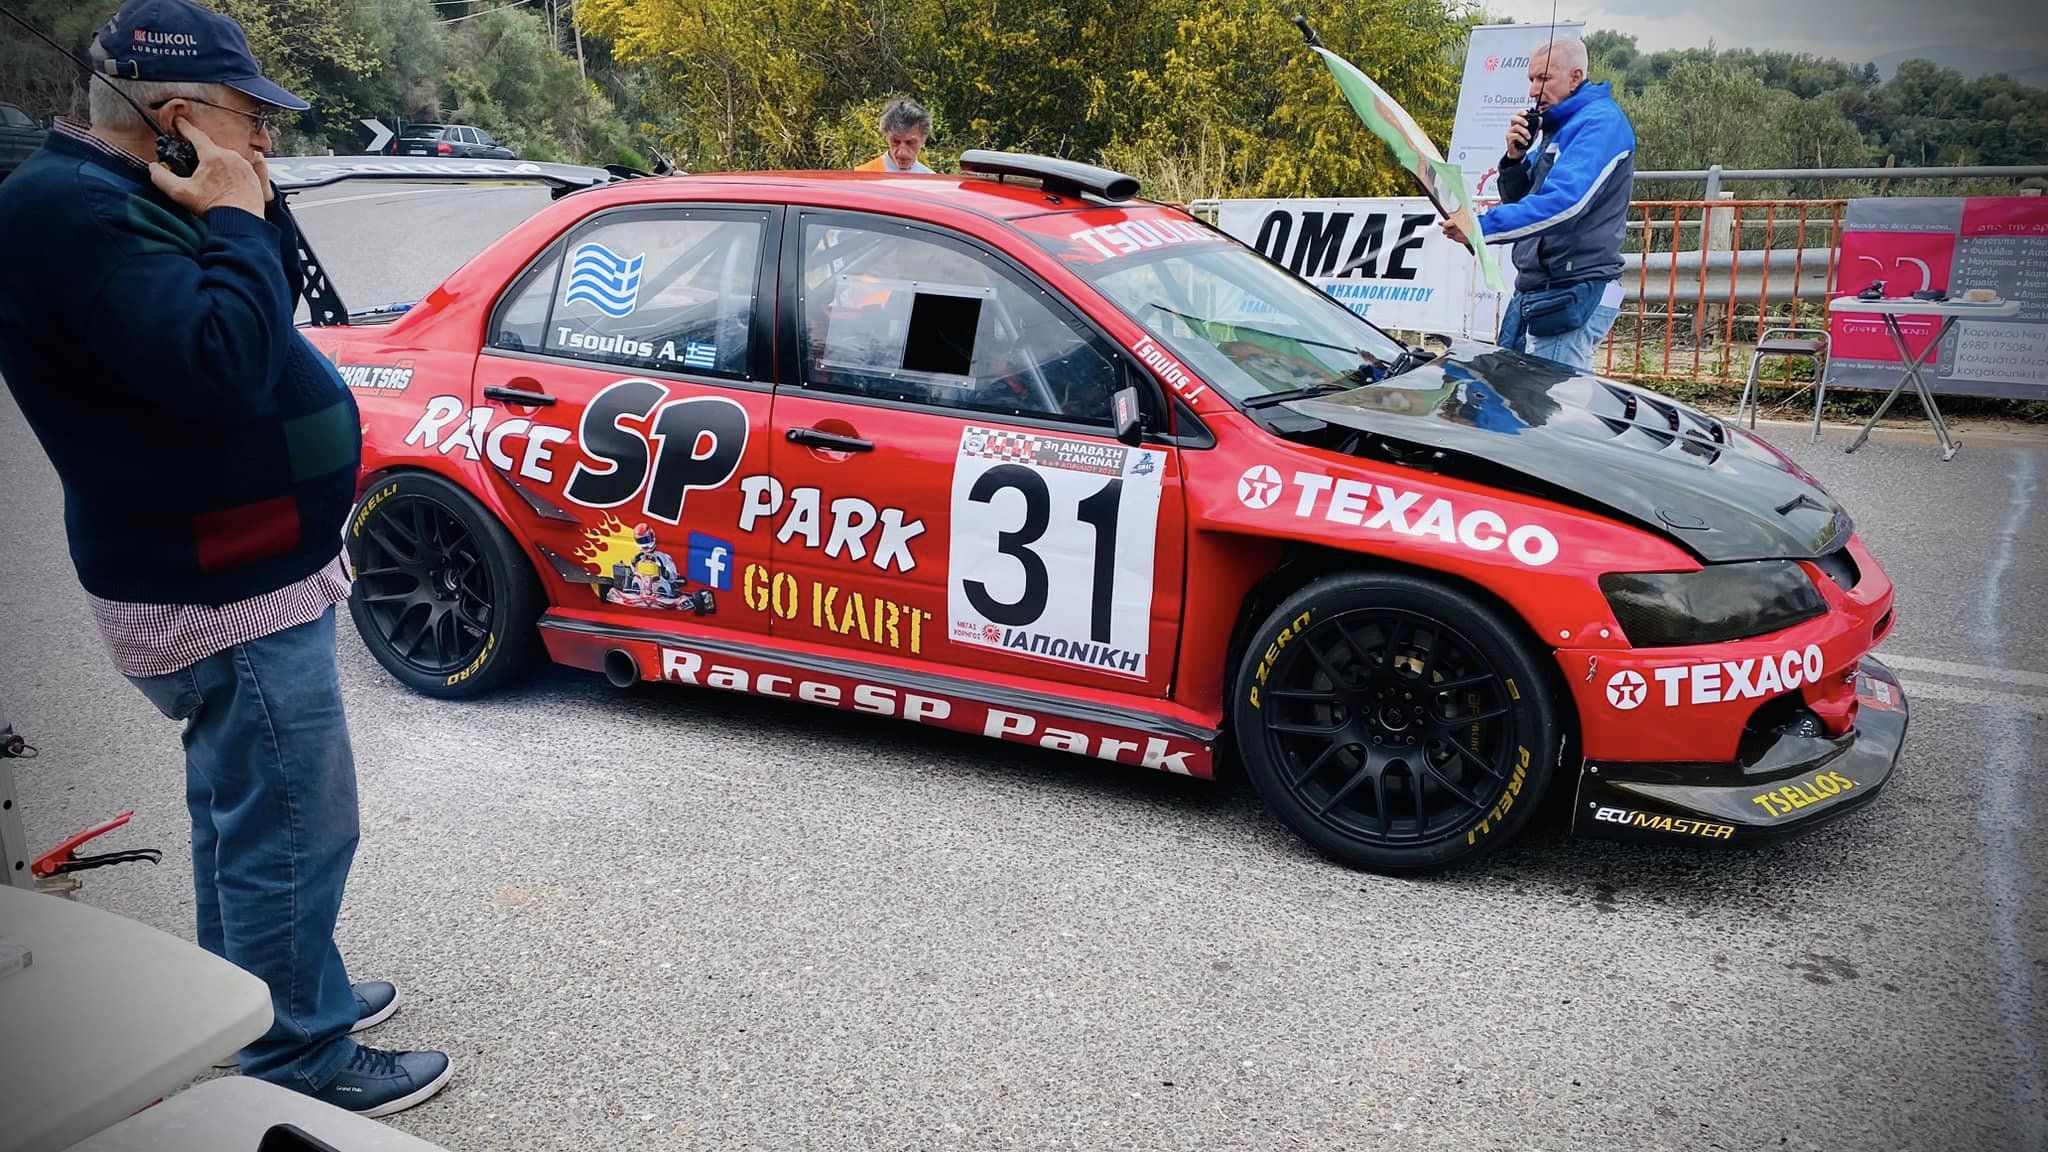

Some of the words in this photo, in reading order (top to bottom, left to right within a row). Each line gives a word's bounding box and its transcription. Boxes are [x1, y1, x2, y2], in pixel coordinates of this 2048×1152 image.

[132, 44, 198, 56] LUBRICANTS
[147, 32, 198, 47] LUKOIL
[1326, 284, 1434, 302] ΜΗΧΑΝΟΚΙΝΗΤΟΥ
[558, 326, 653, 357] Tsoulos
[658, 340, 684, 362] A.
[1132, 334, 1190, 390] Tsoulos
[1184, 385, 1206, 404] J.
[403, 395, 573, 483] RACE
[563, 378, 750, 525] SP
[738, 475, 926, 573] PARK
[1057, 452, 1121, 469] ΤΣΑΚΩΝΑΣ
[1060, 442, 1123, 459] ΑΝΑΒΑΣΗ
[353, 483, 398, 537] PIRELLI
[1293, 471, 1559, 566] TEXACO
[962, 463, 1124, 645] 31
[743, 563, 799, 620] GO
[812, 581, 932, 654] KART
[1002, 628, 1141, 672] ΙΑΠΩΝΙΚΗ
[1654, 643, 1824, 707] TEXACO
[662, 648, 952, 722] RaceSP
[984, 708, 1197, 778] Park
[1250, 686, 1262, 710] P
[1467, 745, 1531, 846] PIRELLI
